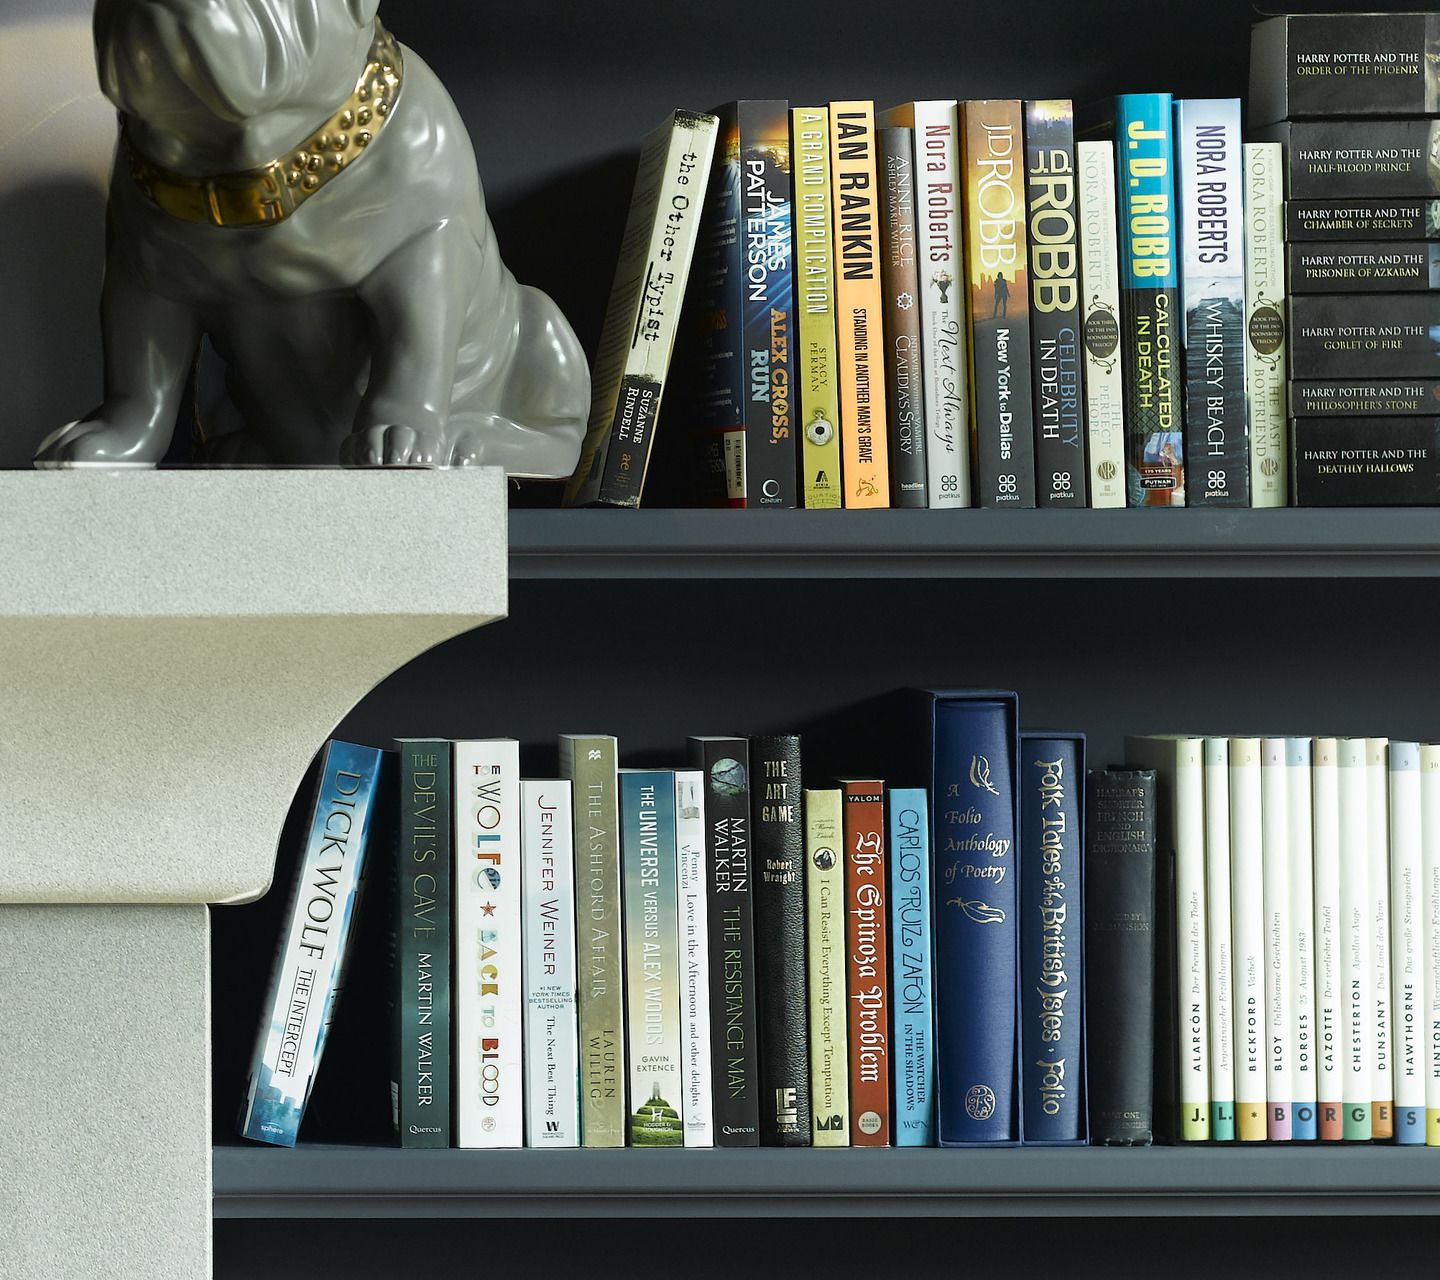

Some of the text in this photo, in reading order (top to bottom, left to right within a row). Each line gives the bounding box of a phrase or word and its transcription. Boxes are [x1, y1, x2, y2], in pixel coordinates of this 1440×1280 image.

[1297, 53, 1419, 63] HARRY POTTER AND THE
[1297, 65, 1419, 75] ORDER PHOENIX
[746, 160, 768, 301] PATTERSON
[766, 190, 787, 271] JAMES
[801, 131, 828, 313] GRAND COMPLICATION
[836, 112, 874, 280] IAN RANKIN
[925, 125, 953, 262] Nora Roberts
[976, 158, 1017, 269] ROBB
[1195, 125, 1229, 264] NORA ROBERTS
[1252, 148, 1268, 288] NORA ROBERTS
[1304, 220, 1414, 230] CHAMBER SECRETS
[644, 152, 697, 342] the Other Typist
[1029, 175, 1078, 313] ROBB
[1130, 194, 1170, 277] ROBB
[1306, 267, 1420, 278] PRISONER AZKABAN
[751, 349, 770, 403] RUN
[769, 308, 789, 444] ALEX CROSS,
[810, 342, 819, 392] PERMAN
[819, 347, 827, 386] STACY
[1137, 341, 1153, 408] DEATH
[1154, 293, 1173, 429] CALCULATED
[1205, 301, 1225, 456] WHISKEY BEACH
[1324, 340, 1403, 350] GOBLET FIRE
[618, 386, 640, 441] RINDELL
[633, 389, 653, 444] SUZANNE
[853, 309, 873, 464] STANDING ANOTHER GRAVE
[996, 328, 1014, 460] New York Dallas
[1040, 368, 1060, 440] DEATH
[1058, 327, 1079, 449] CELEBRITY
[1386, 400, 1418, 409] STONE
[1318, 463, 1414, 474] DEATHLY HALLOWS
[764, 760, 787, 778] THE
[765, 783, 787, 800] ART
[762, 806, 794, 823] GAME
[944, 832, 1010, 857] Anthology
[299, 769, 362, 960] DICK WOLF
[413, 772, 437, 939] DEVIL'S CAVE
[537, 795, 560, 976] JENNIFER WEINER
[714, 818, 730, 893] WALKER
[731, 818, 748, 893] MARTIN
[851, 832, 883, 876] The
[897, 809, 923, 947] CARLOS RUIZ
[961, 864, 1007, 884] Poetry
[639, 811, 663, 982] UNIVERSE VERSUS ALEX
[850, 883, 884, 978] Spinoza
[1036, 812, 1068, 1043] Tales British Isles
[417, 953, 433, 1106] MARTIN WALKER
[724, 949, 744, 1050] RESISTANCE
[851, 985, 885, 1083] Problem
[1248, 997, 1256, 1072] BECKFORD
[1352, 980, 1361, 1072] CHESTERTON
[1378, 1000, 1386, 1070] DUNSANY
[1405, 983, 1414, 1076] HAWTHORNE
[278, 999, 306, 1078] INTERCEPT
[603, 1029, 616, 1098] LAUREN
[916, 1045, 926, 1104] WATCHER
[1274, 1036, 1282, 1071] BLOY
[1299, 1014, 1308, 1071] BORGES
[1324, 1007, 1333, 1072] CAZOTTE
[821, 1046, 834, 1108] Temptation
[905, 1060, 915, 1111] SHADOWS
[410, 1125, 441, 1134] Quercus
[722, 1126, 755, 1135] Quercus
